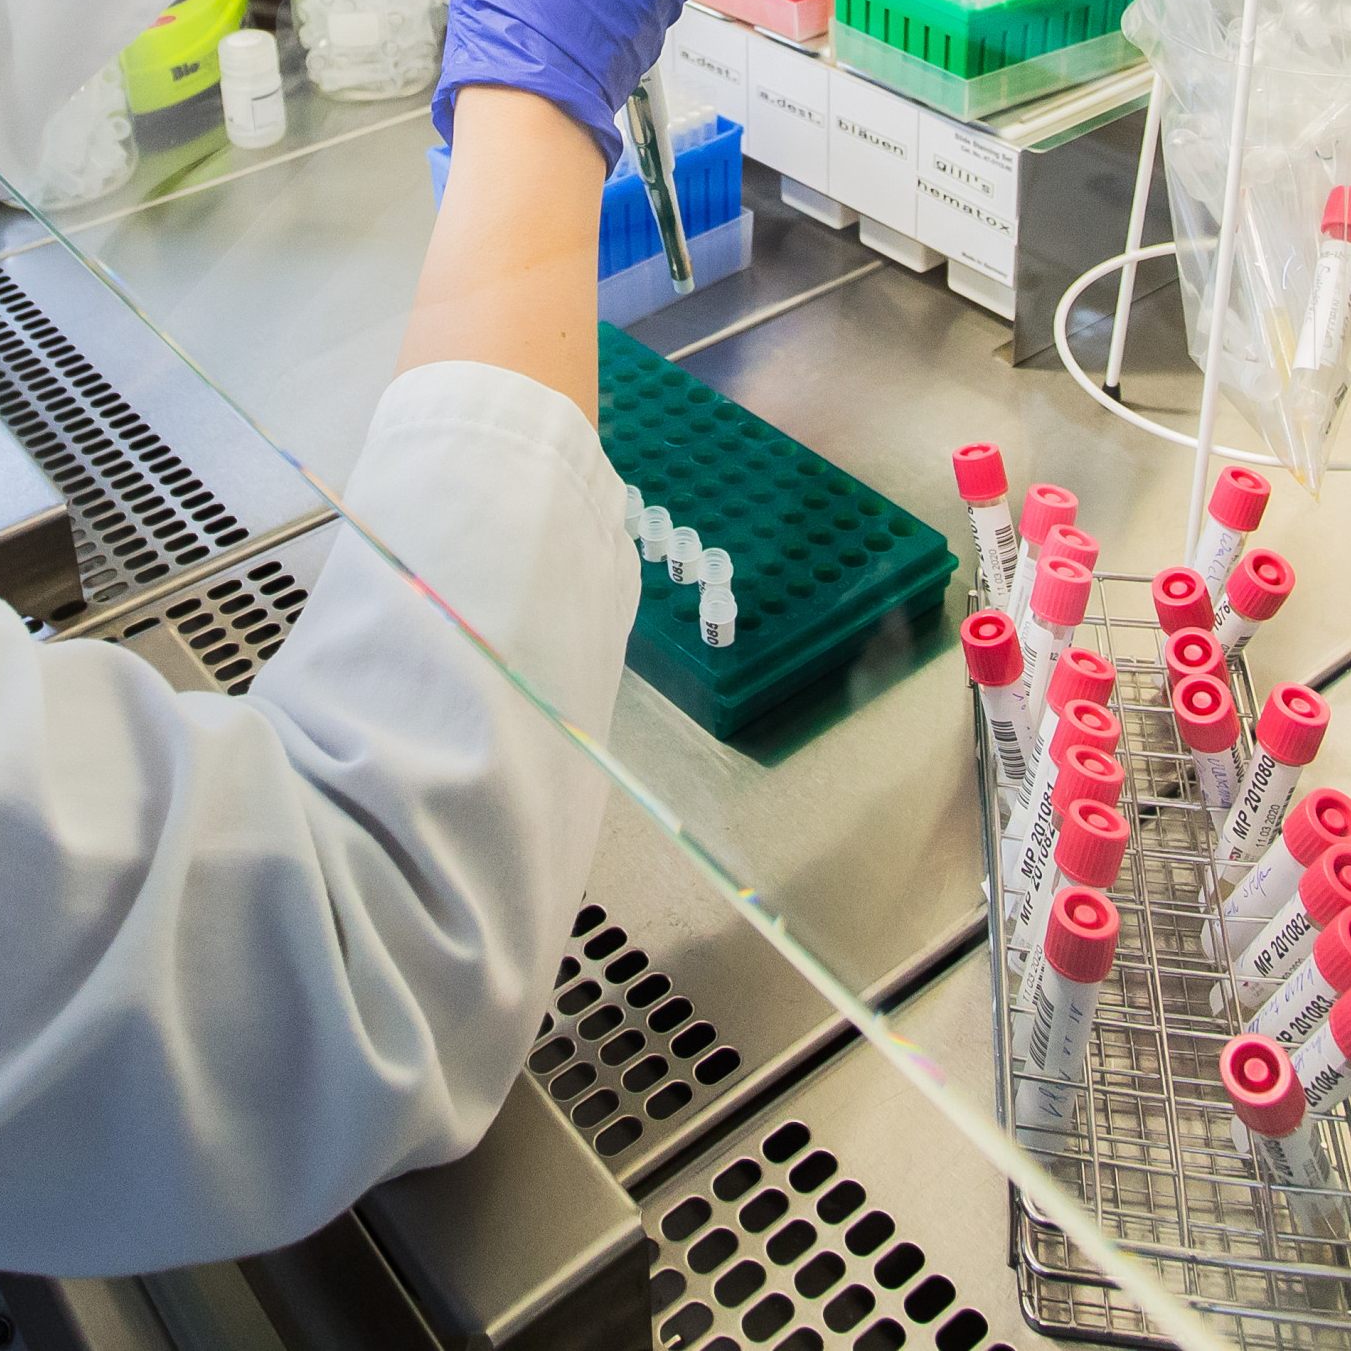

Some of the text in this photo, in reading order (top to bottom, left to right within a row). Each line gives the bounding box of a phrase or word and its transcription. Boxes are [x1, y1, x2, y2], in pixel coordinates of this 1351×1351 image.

[838, 119, 905, 156] bläuen
[935, 160, 991, 195] gill's
[917, 178, 1011, 235] hematox
[1232, 809, 1252, 840] MP
[1244, 754, 1276, 814] 201080
[1021, 781, 1055, 879] MP 201081
[1019, 891, 1034, 926] MP
[1253, 949, 1274, 977] MP
[1270, 912, 1312, 960] 201082
[1304, 1064, 1345, 1108] 201084
